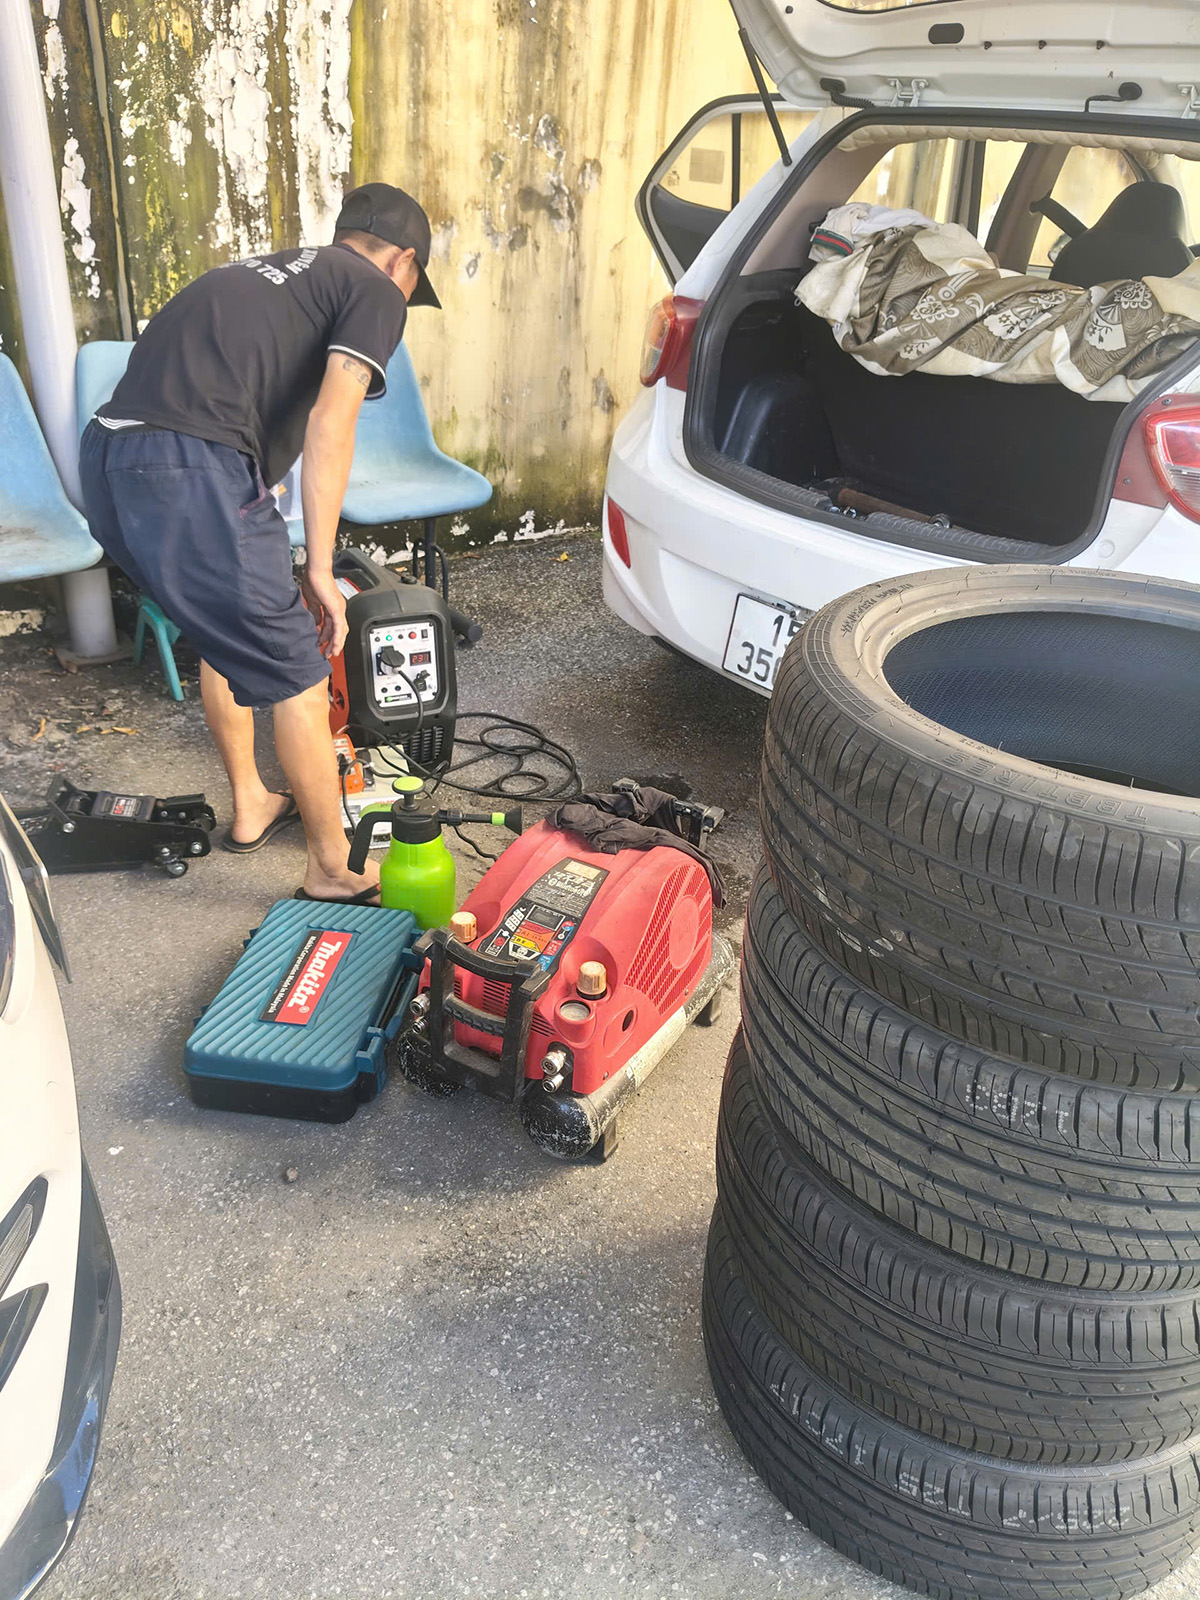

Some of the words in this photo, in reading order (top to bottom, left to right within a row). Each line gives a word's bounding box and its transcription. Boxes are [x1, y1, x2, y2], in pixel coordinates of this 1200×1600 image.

[257, 264, 289, 285] 725
[288, 949, 309, 974] Corporation
[287, 941, 343, 1008] Makita
